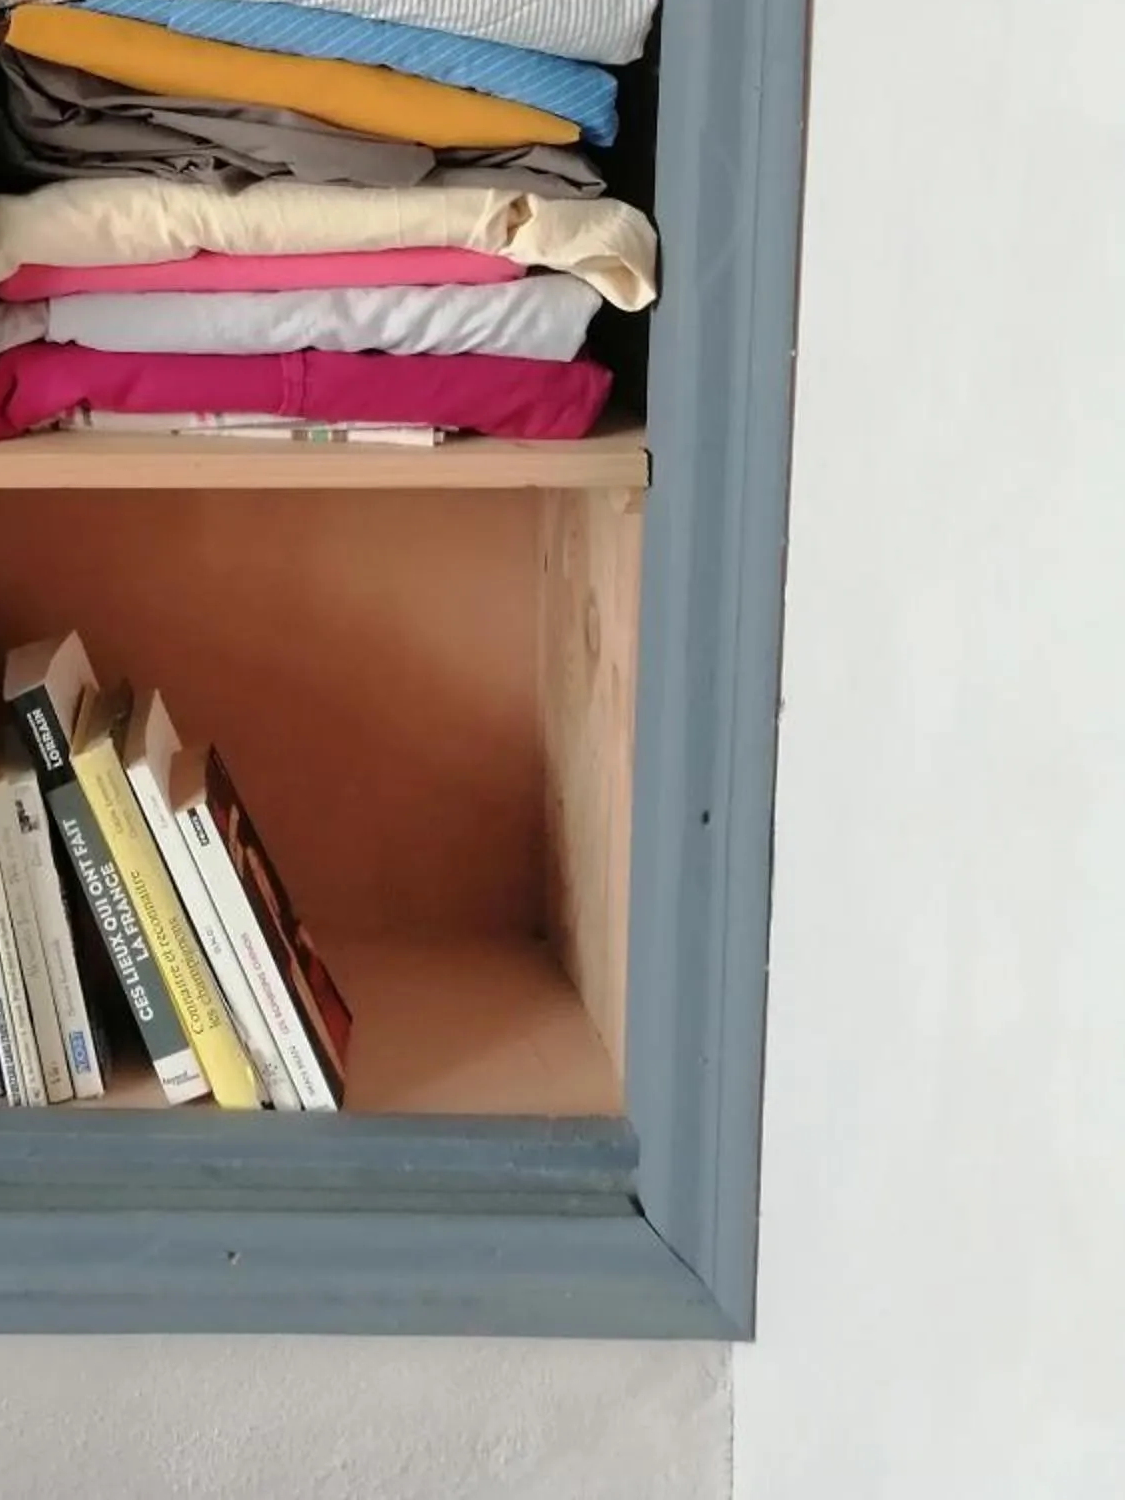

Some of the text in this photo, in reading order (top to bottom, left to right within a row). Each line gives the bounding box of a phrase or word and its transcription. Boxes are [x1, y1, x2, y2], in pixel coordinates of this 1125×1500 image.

[32, 708, 63, 767] LORRAIN
[63, 820, 153, 1021] CES LIEUX QUI ONT FAIT
[100, 861, 150, 963] LA FRANCE
